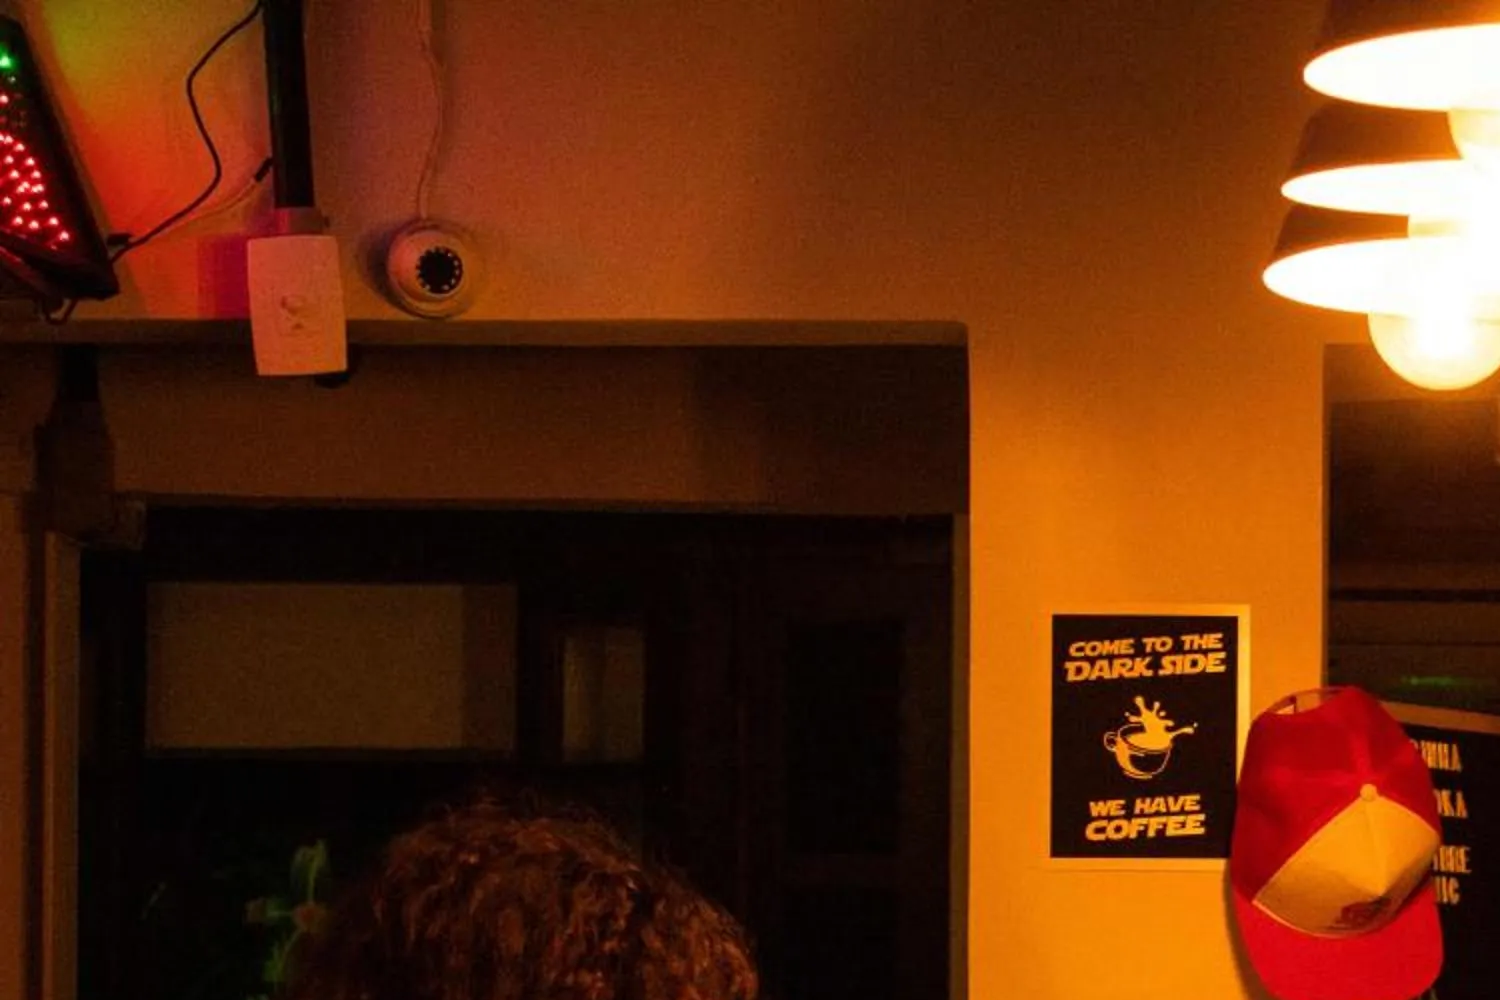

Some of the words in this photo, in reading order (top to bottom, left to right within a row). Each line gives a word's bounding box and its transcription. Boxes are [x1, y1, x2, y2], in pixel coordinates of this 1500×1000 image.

[1068, 638, 1135, 657] COME
[1142, 637, 1173, 653] TO
[1181, 633, 1224, 650] THE
[1064, 656, 1153, 682] DARK
[1158, 652, 1227, 676] SIDE
[1089, 800, 1126, 817] WE
[1134, 795, 1201, 815] HAVE
[1085, 813, 1206, 841] COFFEE
